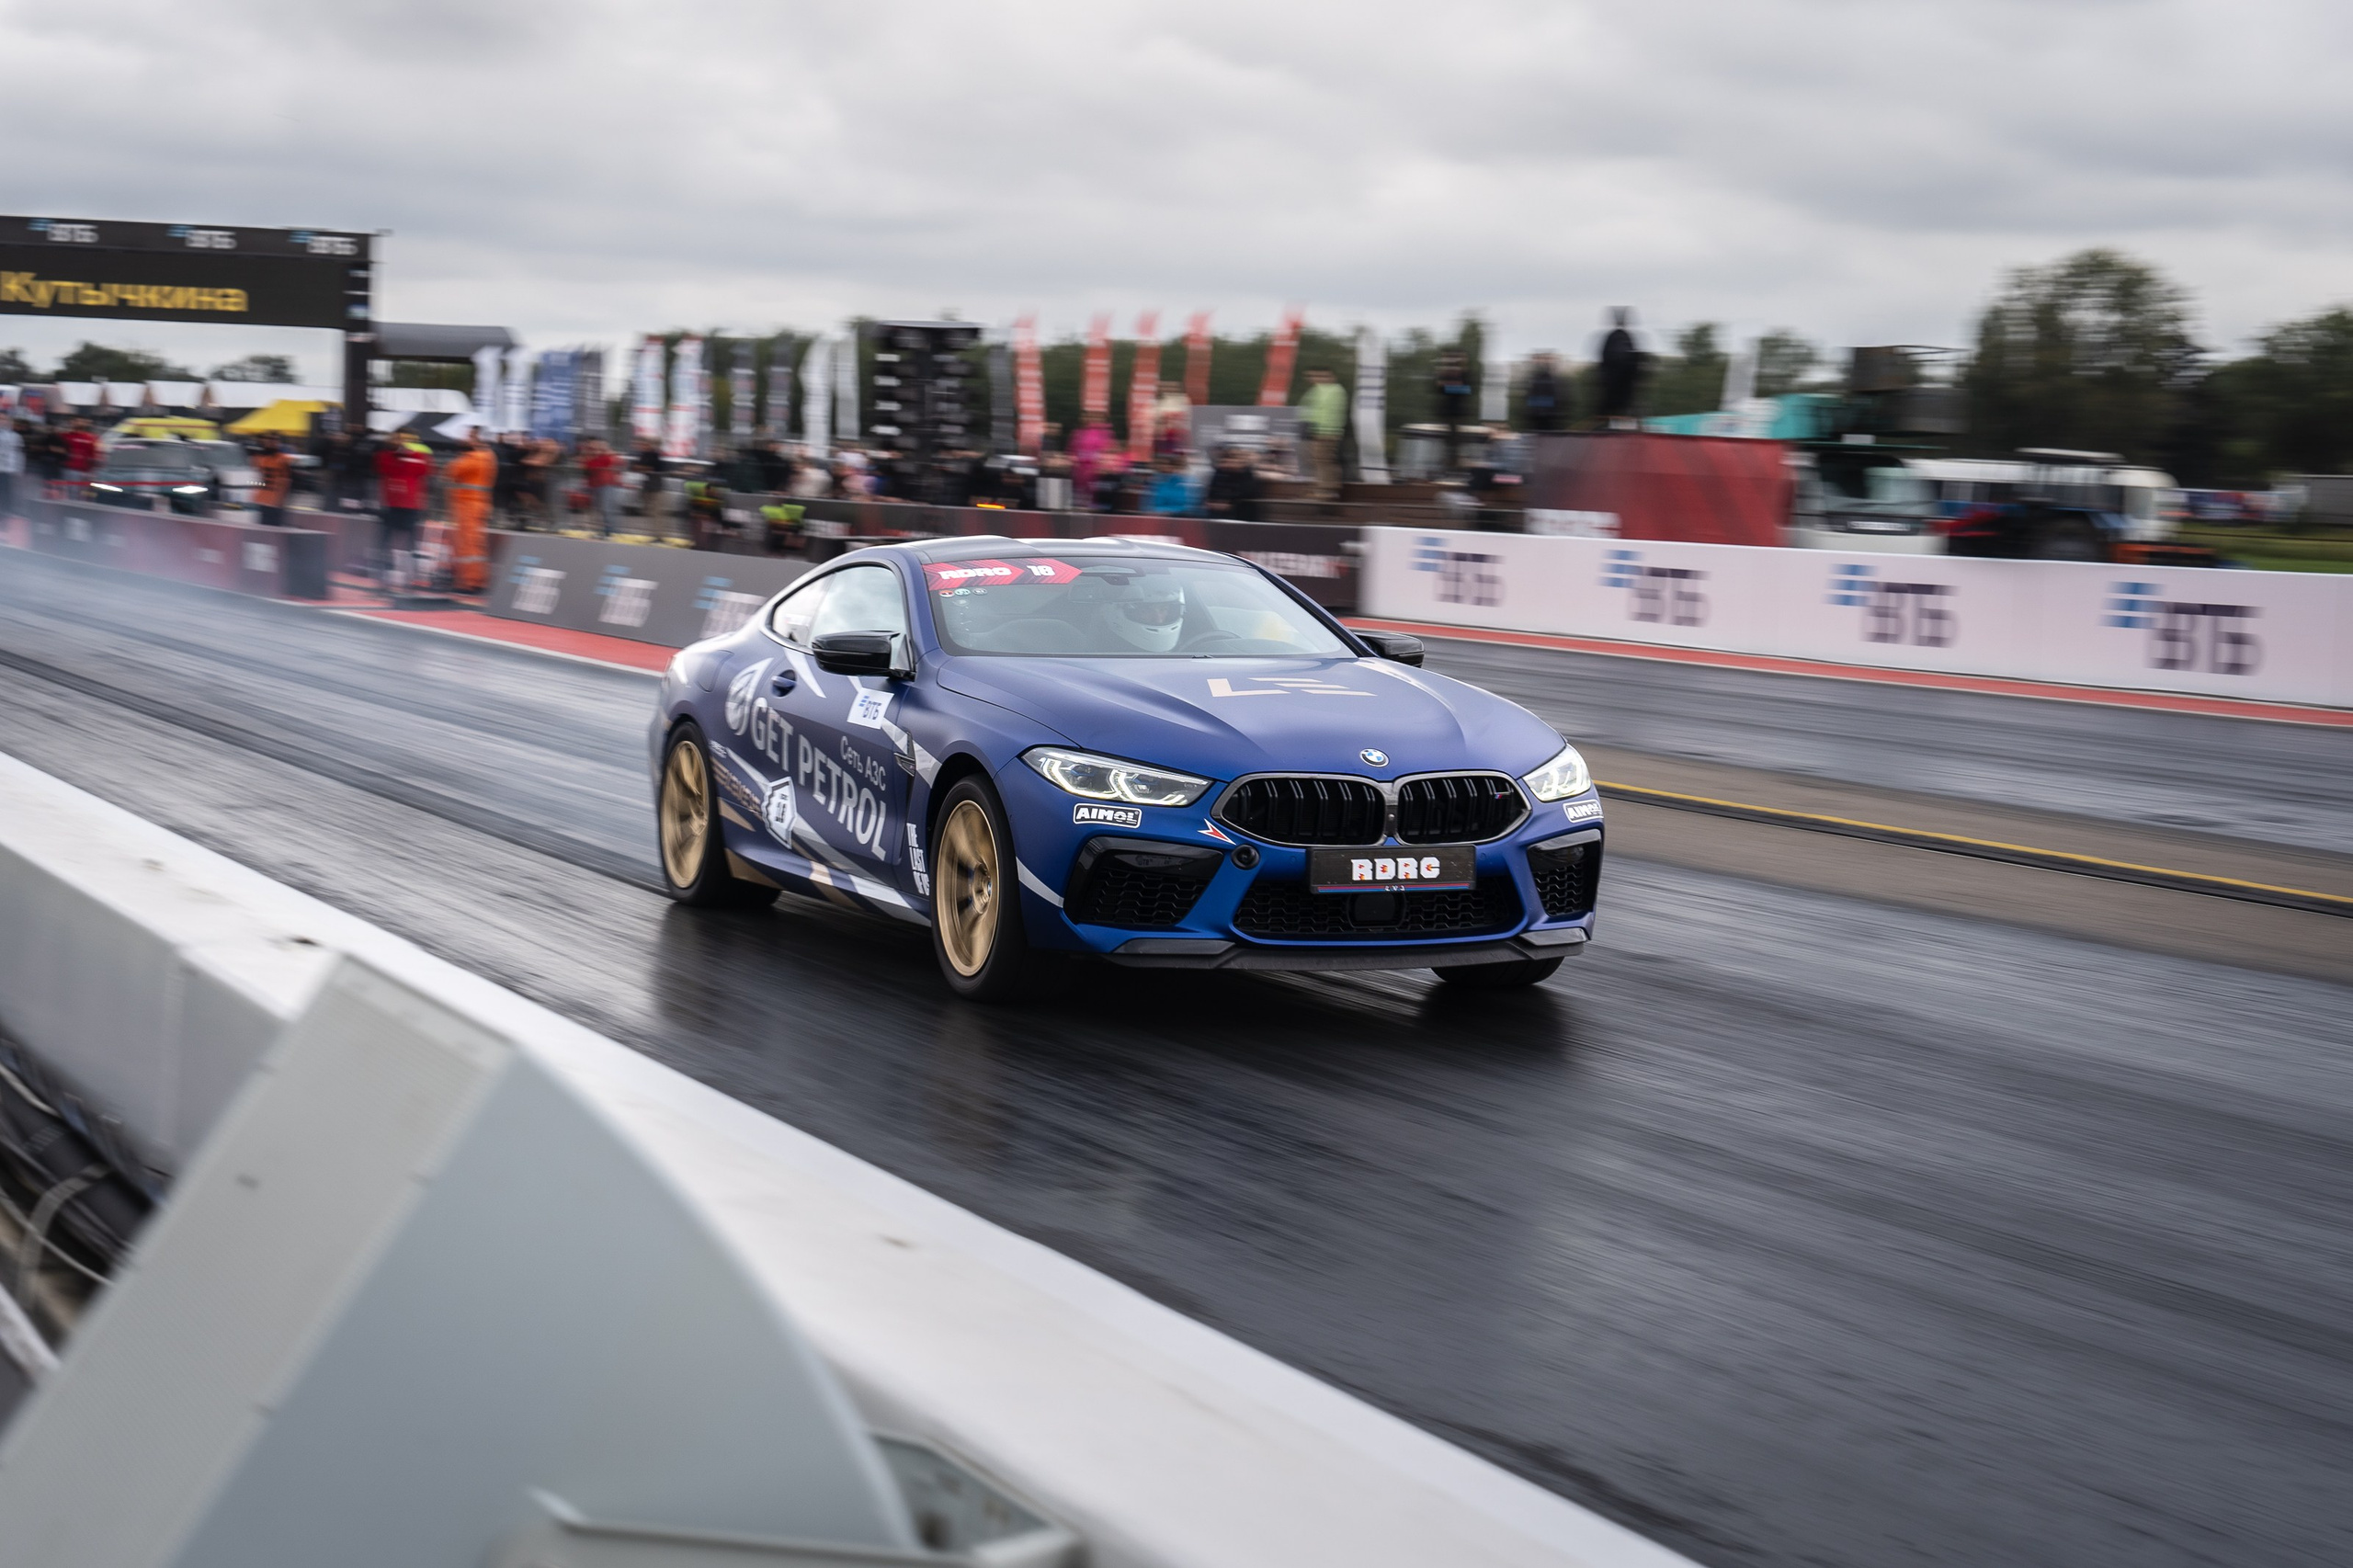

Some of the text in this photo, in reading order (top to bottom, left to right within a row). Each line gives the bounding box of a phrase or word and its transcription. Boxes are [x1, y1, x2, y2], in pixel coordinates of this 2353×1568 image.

[1027, 565, 1055, 576] 18
[750, 697, 793, 772] GET
[798, 734, 886, 861] PETROL
[840, 735, 885, 791] Сеть АЗС
[1350, 857, 1440, 881] RDRC
